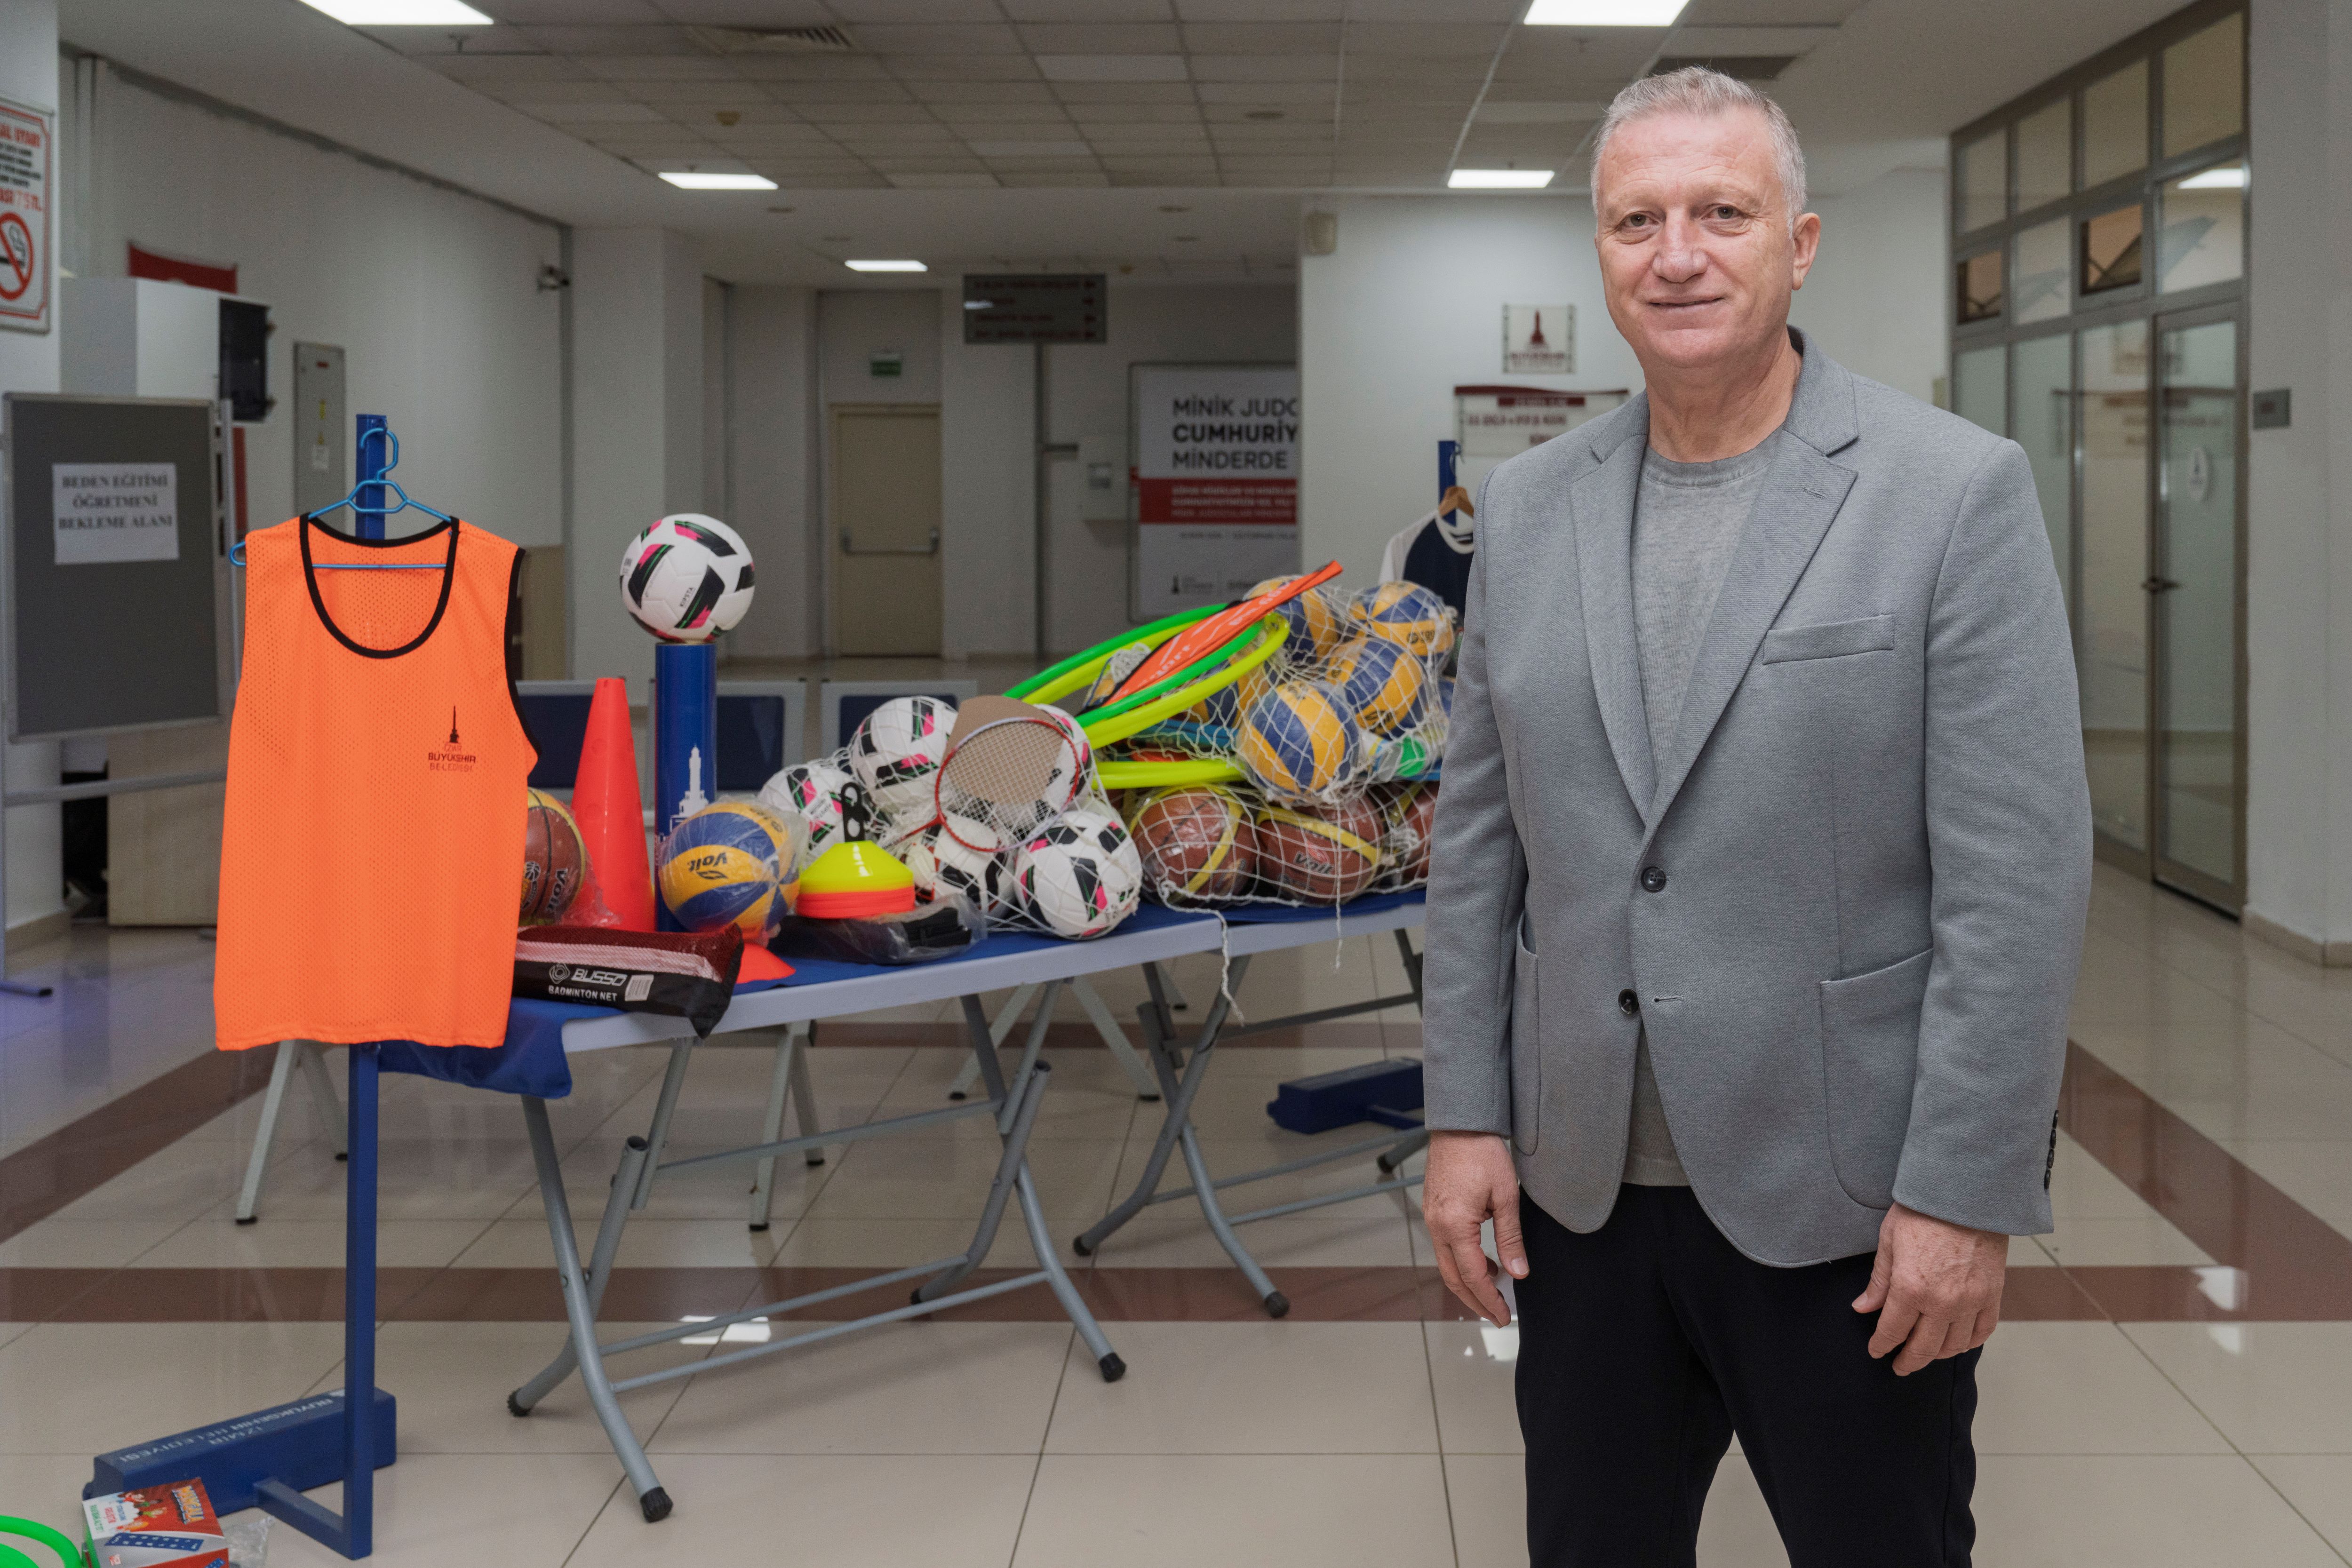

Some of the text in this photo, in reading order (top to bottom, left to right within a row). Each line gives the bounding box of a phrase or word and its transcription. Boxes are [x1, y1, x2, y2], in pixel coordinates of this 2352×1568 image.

[1173, 394, 1236, 417] MİNİK
[1173, 447, 1288, 469] MİNDERDE
[63, 475, 110, 488] BEDEN
[59, 514, 173, 529] BEKLEME ALANI
[571, 968, 628, 987] BUSSO
[548, 985, 598, 1000] BADMINTON
[600, 992, 618, 1002] NET
